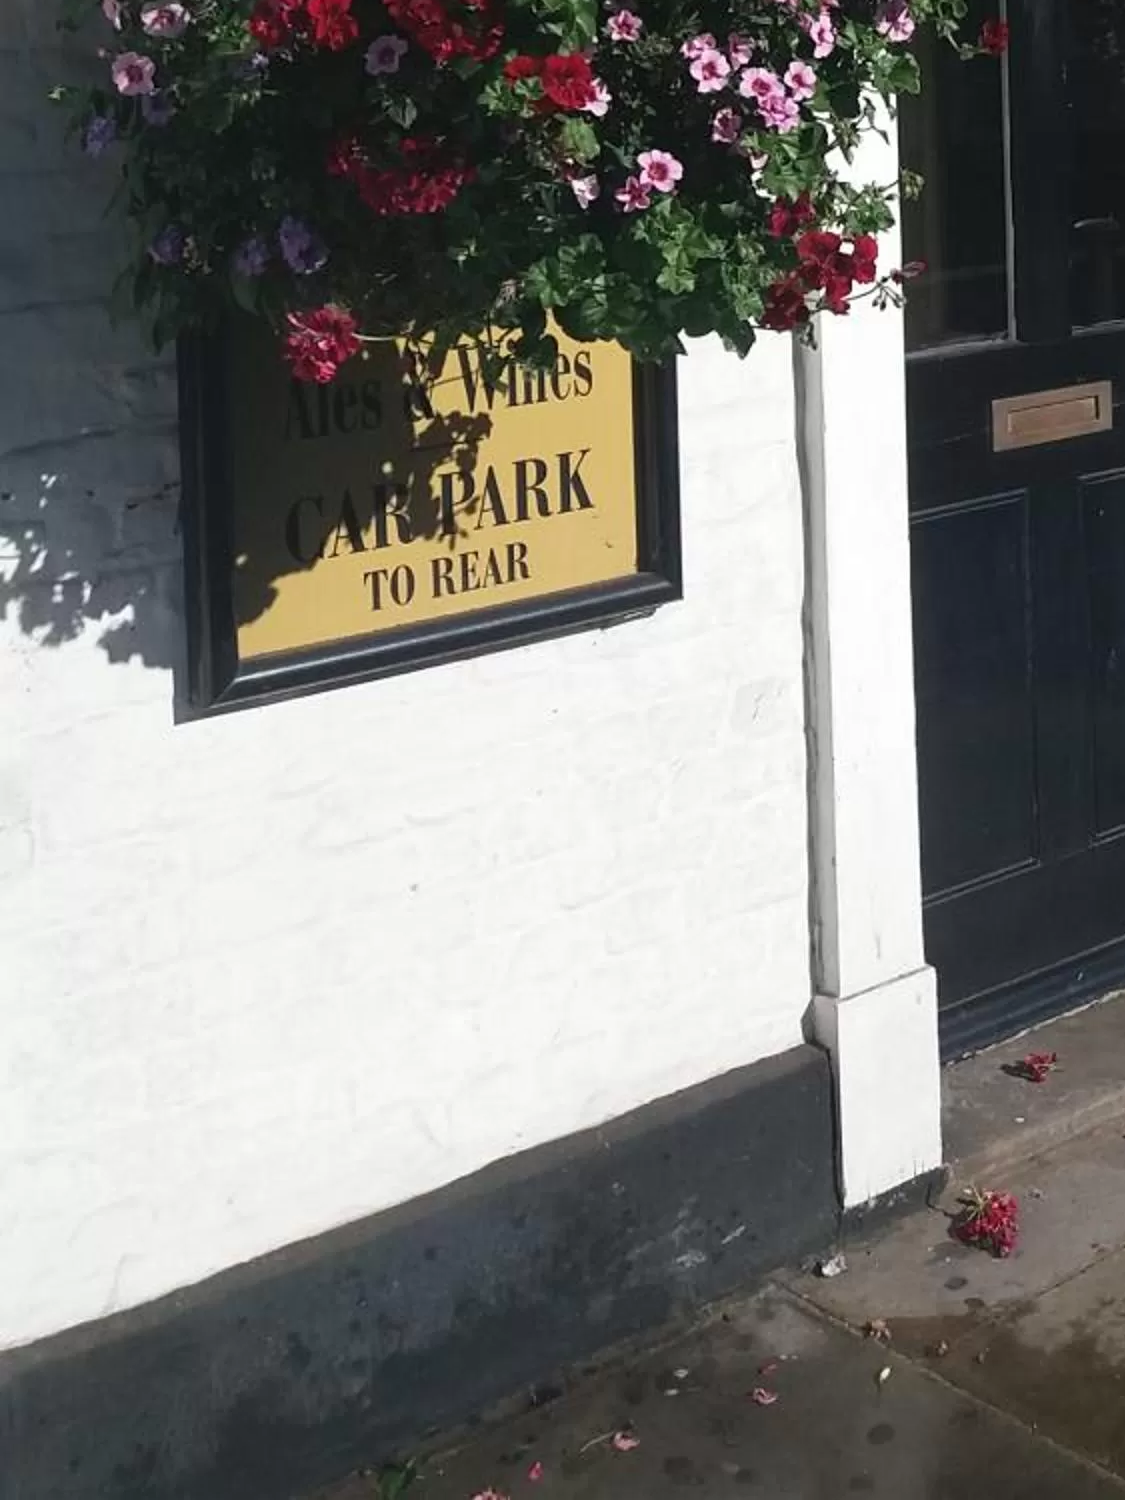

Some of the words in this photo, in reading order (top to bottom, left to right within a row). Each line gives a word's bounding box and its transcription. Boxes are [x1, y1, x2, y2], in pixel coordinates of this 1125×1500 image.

[284, 380, 383, 441] Ales
[285, 483, 416, 564] CAR
[437, 449, 595, 535] PARK
[364, 565, 415, 611] TO
[431, 541, 530, 599] REAR
